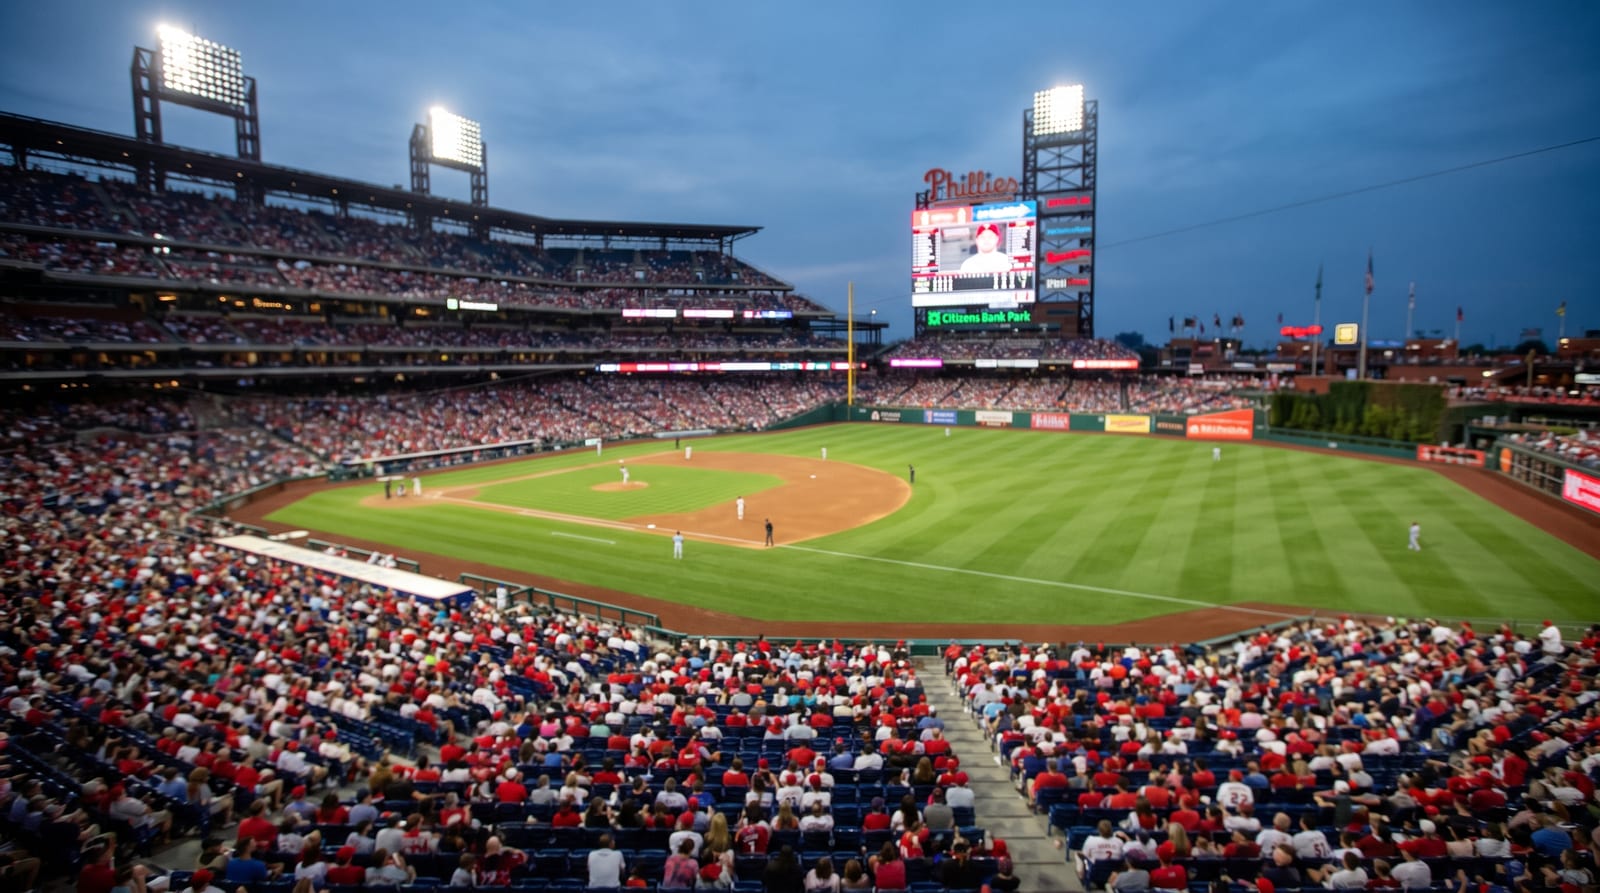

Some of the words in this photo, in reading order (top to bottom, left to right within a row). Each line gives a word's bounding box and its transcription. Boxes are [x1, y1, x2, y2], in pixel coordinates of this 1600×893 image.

[923, 167, 1019, 202] Phillies
[942, 312, 980, 323] Citizens
[982, 311, 1005, 322] Bank
[1007, 310, 1030, 322] Park
